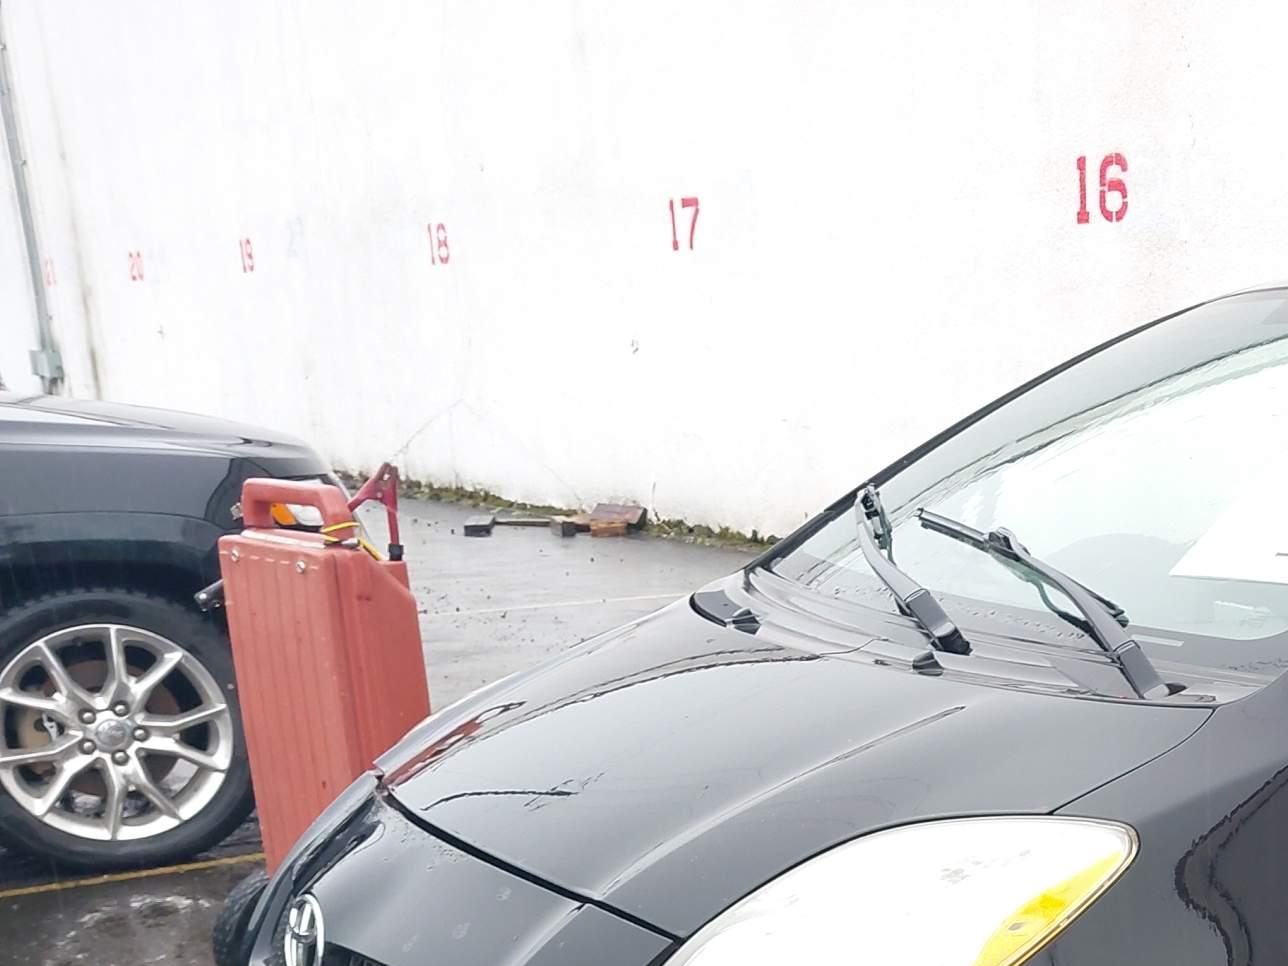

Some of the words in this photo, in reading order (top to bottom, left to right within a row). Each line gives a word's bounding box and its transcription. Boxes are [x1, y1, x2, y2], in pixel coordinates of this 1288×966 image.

[1076, 152, 1128, 225] 16
[428, 223, 450, 265] 18
[669, 196, 700, 250] 17
[128, 251, 144, 281] 20
[239, 239, 255, 272] 19
